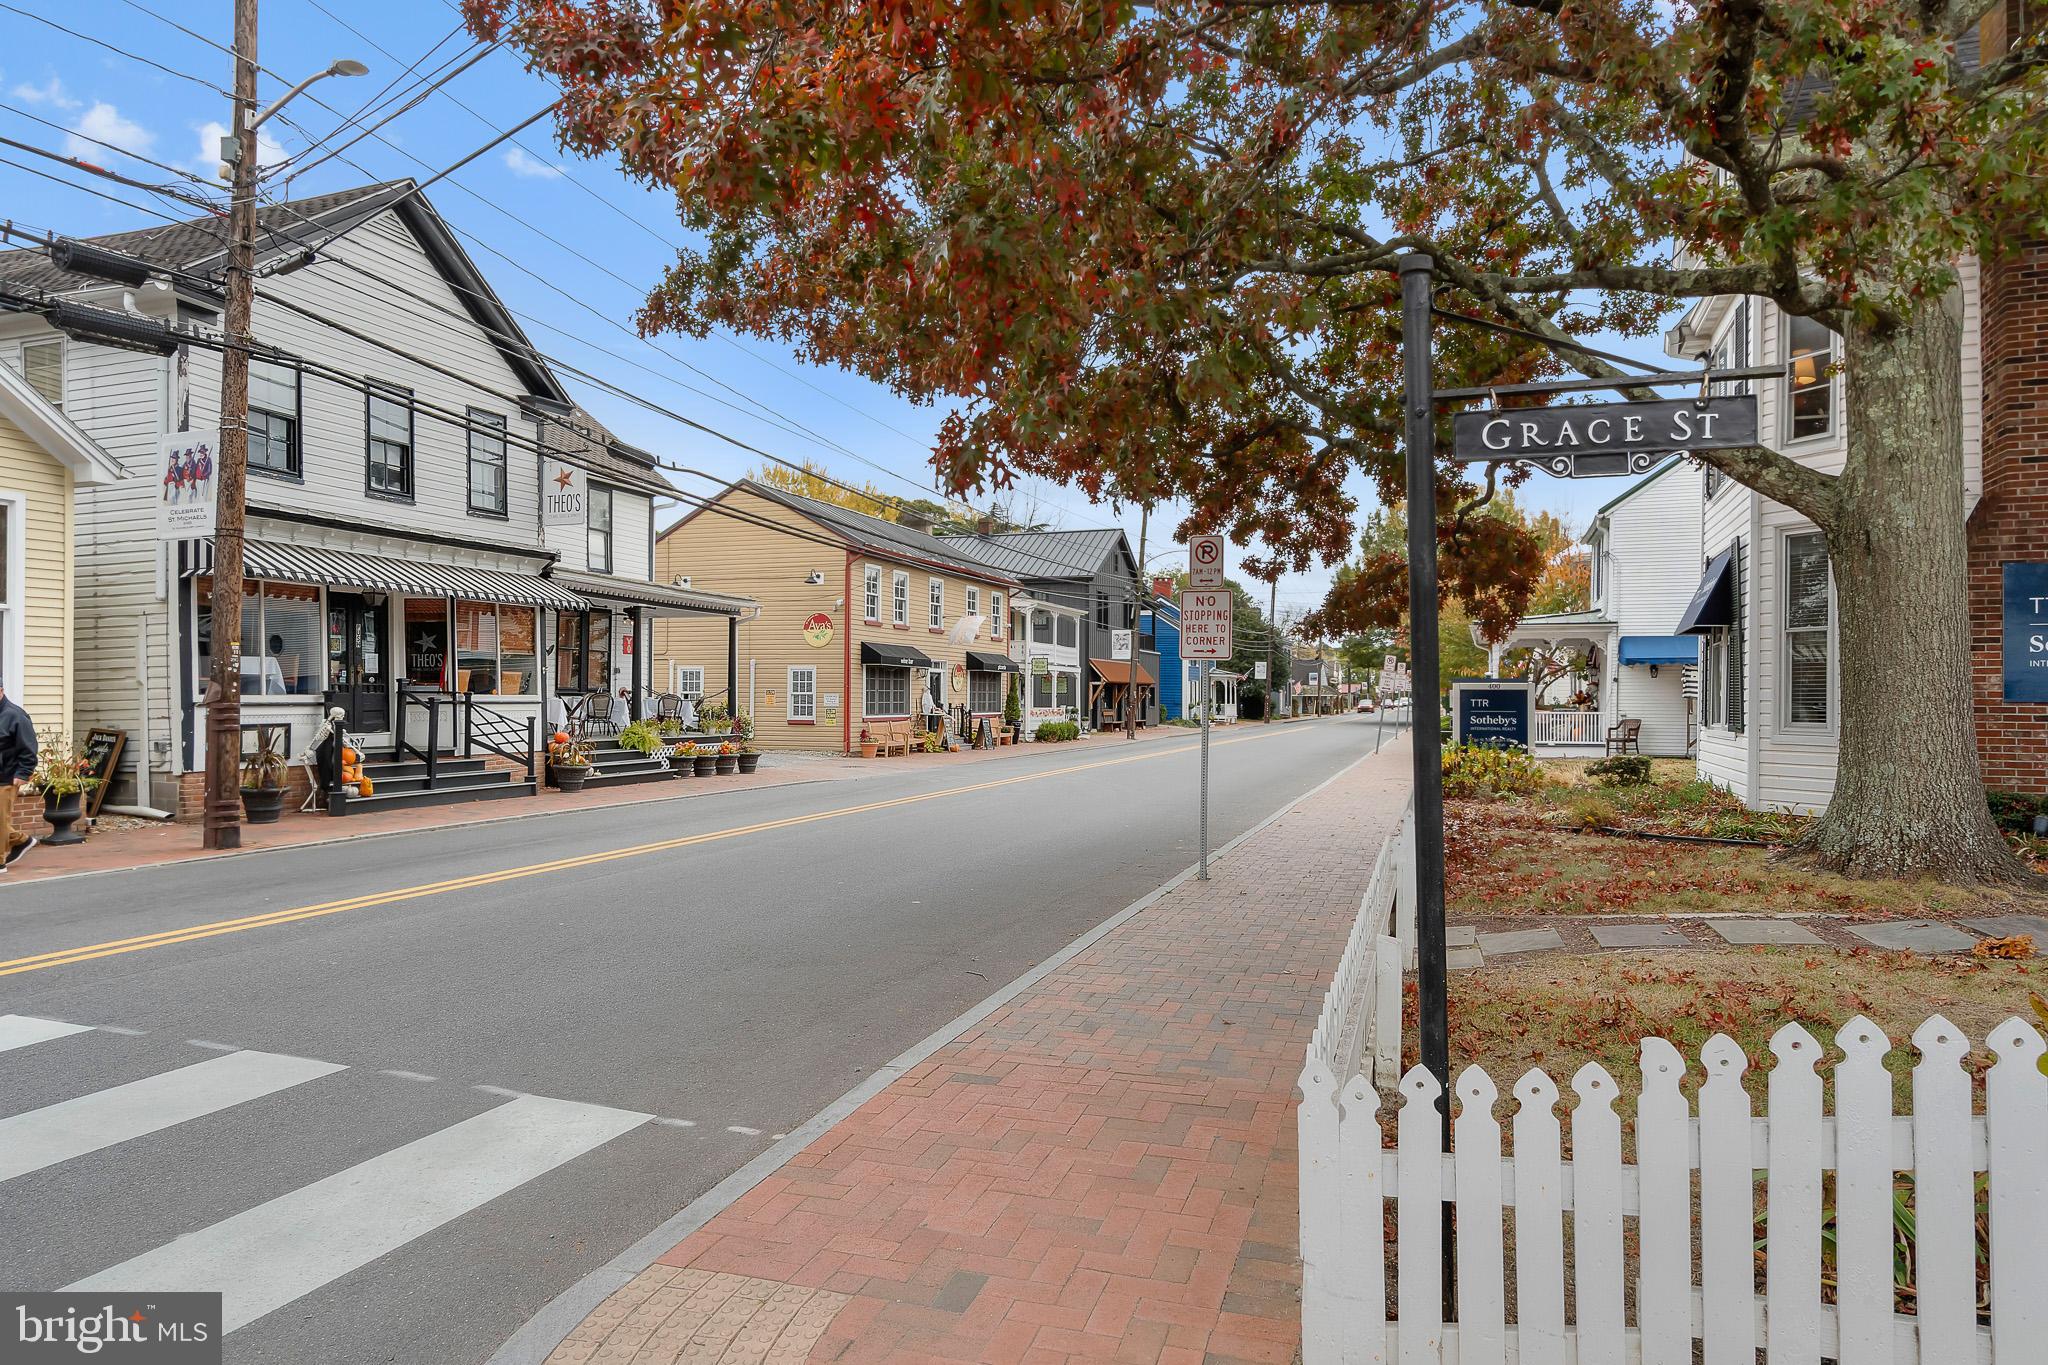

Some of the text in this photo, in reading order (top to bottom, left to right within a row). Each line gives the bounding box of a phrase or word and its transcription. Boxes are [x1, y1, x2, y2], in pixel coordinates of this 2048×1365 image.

[1482, 410, 1719, 450] GRACE ST
[547, 493, 581, 513] THEO'S
[170, 507, 205, 516] CELEBRATE
[1195, 595, 1216, 607] NO
[1184, 610, 1228, 621] STOPPING
[809, 619, 832, 631] Ava's
[1185, 624, 1226, 633] HERE TO
[1186, 636, 1225, 646] CORNER
[411, 653, 443, 667] THEO'S
[1470, 699, 1489, 707] TTR
[1470, 715, 1517, 726] Sotheby's
